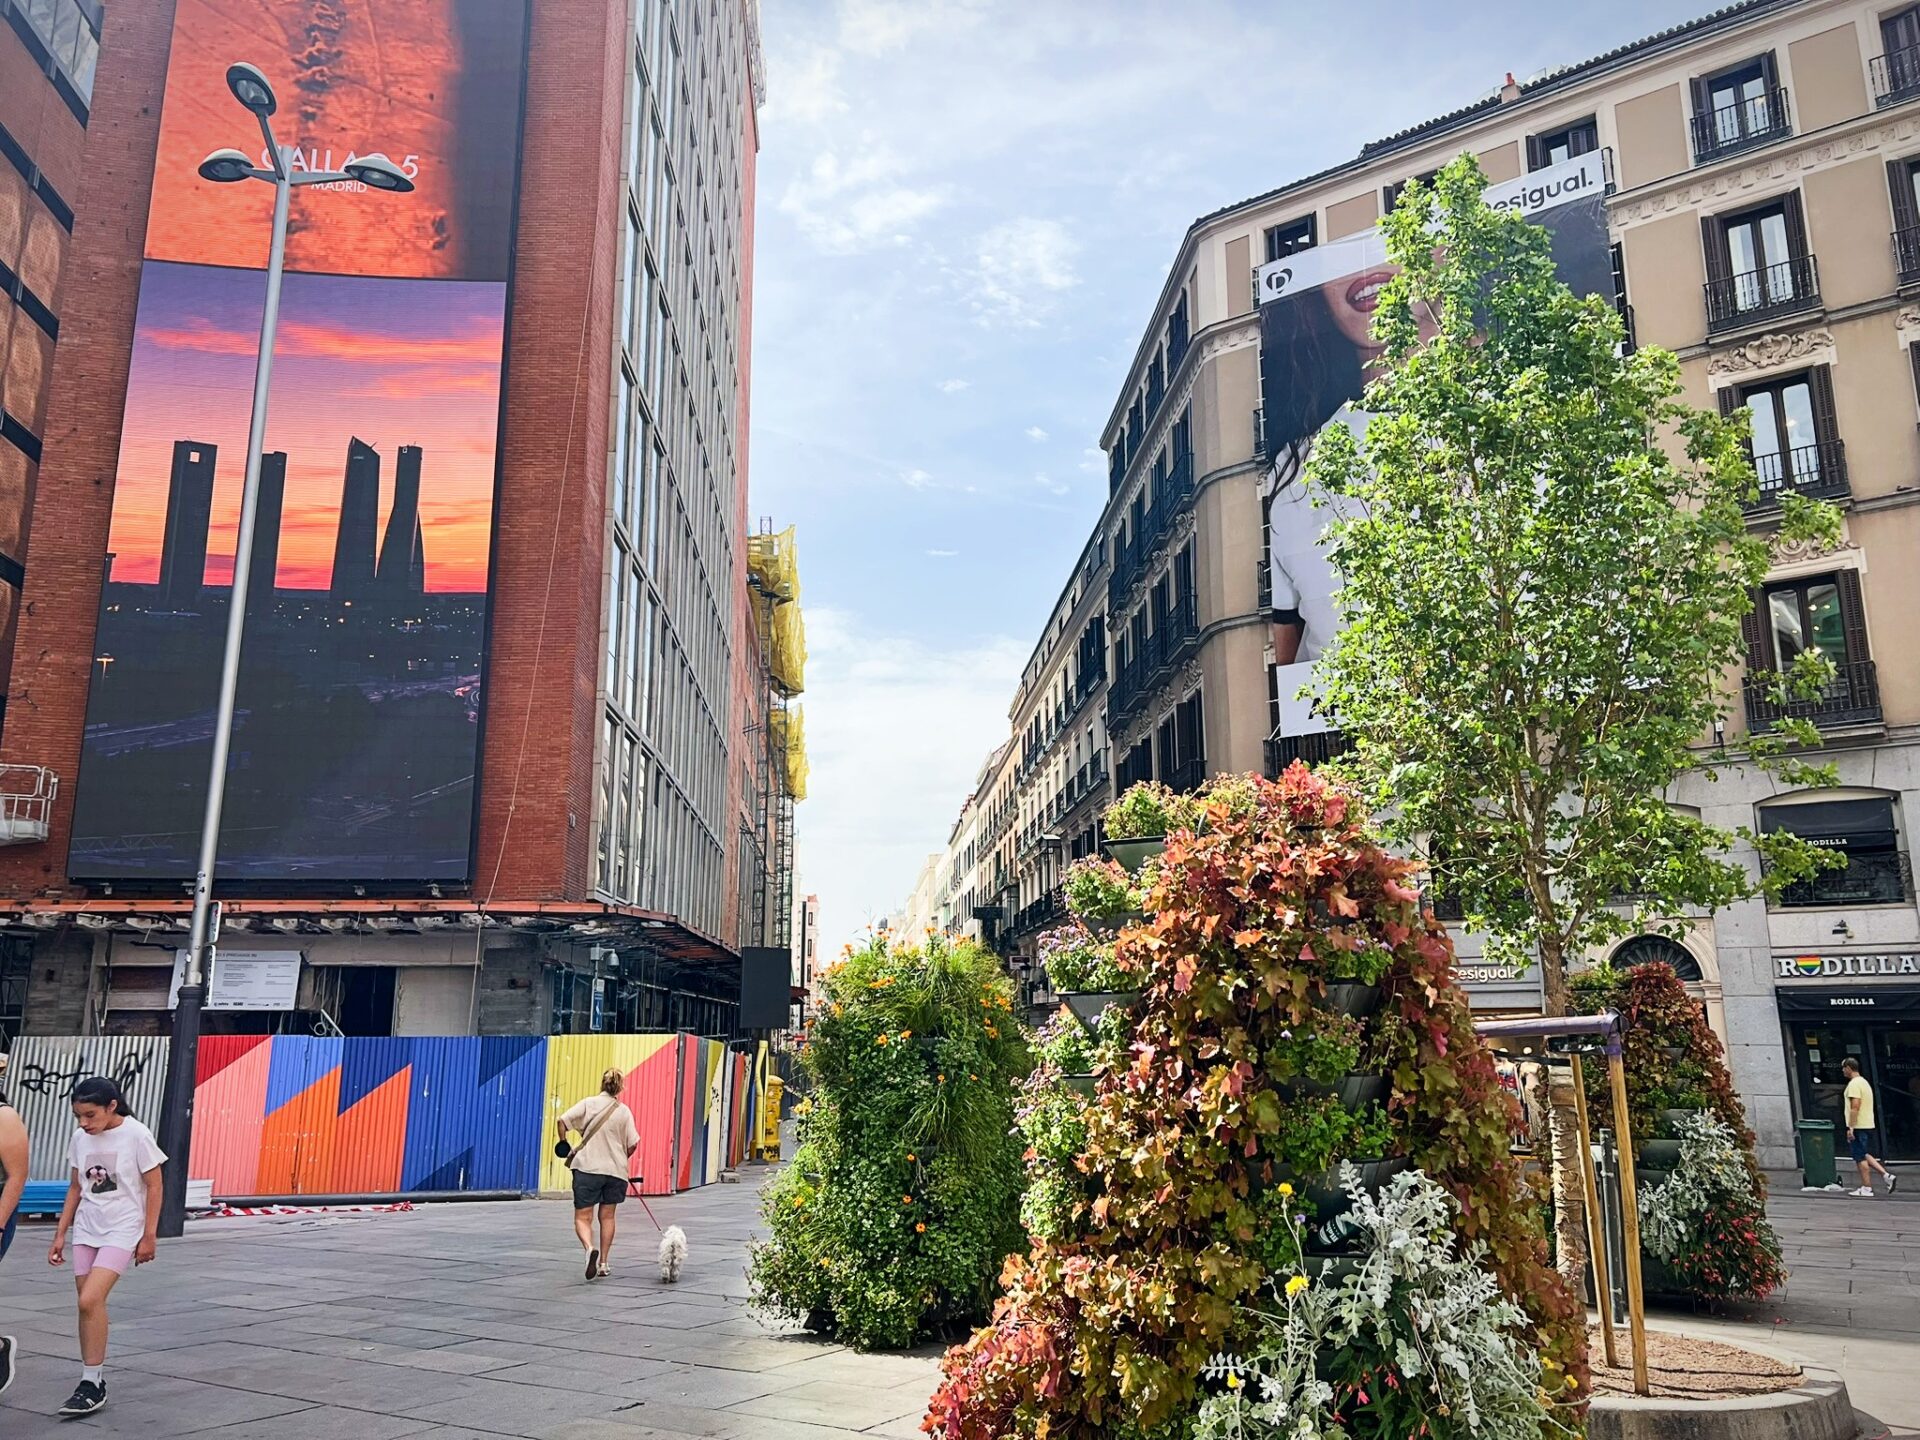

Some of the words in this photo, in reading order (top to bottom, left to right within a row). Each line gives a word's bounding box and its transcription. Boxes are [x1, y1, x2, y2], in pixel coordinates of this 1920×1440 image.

[401, 154, 419, 179] 5
[311, 181, 368, 193] MADRID
[1830, 998, 1875, 1006] RODILLA
